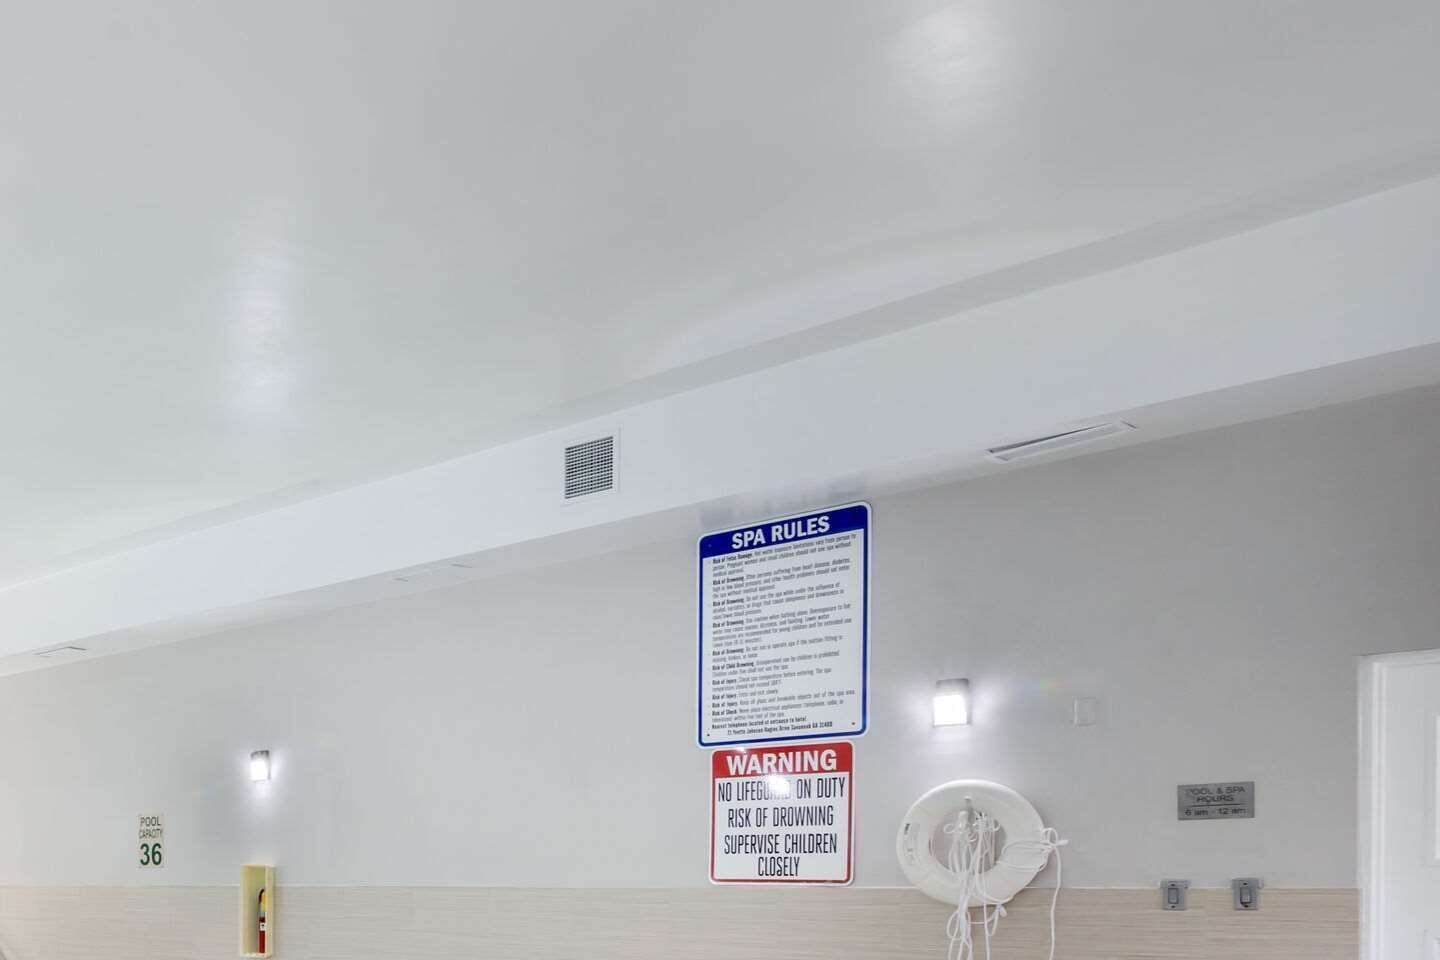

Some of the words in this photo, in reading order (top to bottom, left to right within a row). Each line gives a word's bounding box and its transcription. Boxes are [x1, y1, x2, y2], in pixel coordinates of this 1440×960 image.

[732, 528, 765, 549] SPA
[771, 515, 830, 542] RULES
[727, 749, 837, 775] WARNING
[718, 782, 732, 801] NO
[796, 778, 811, 799] ON
[817, 777, 845, 798] DUTY
[140, 816, 161, 826] POOL
[728, 808, 751, 828] RISK
[756, 807, 768, 827] OF
[773, 805, 834, 827] DROWNING
[140, 843, 162, 866] 36
[724, 834, 780, 855] SUPERVISE
[784, 833, 837, 854] CHILDREN
[758, 857, 800, 877] CLOSELY
